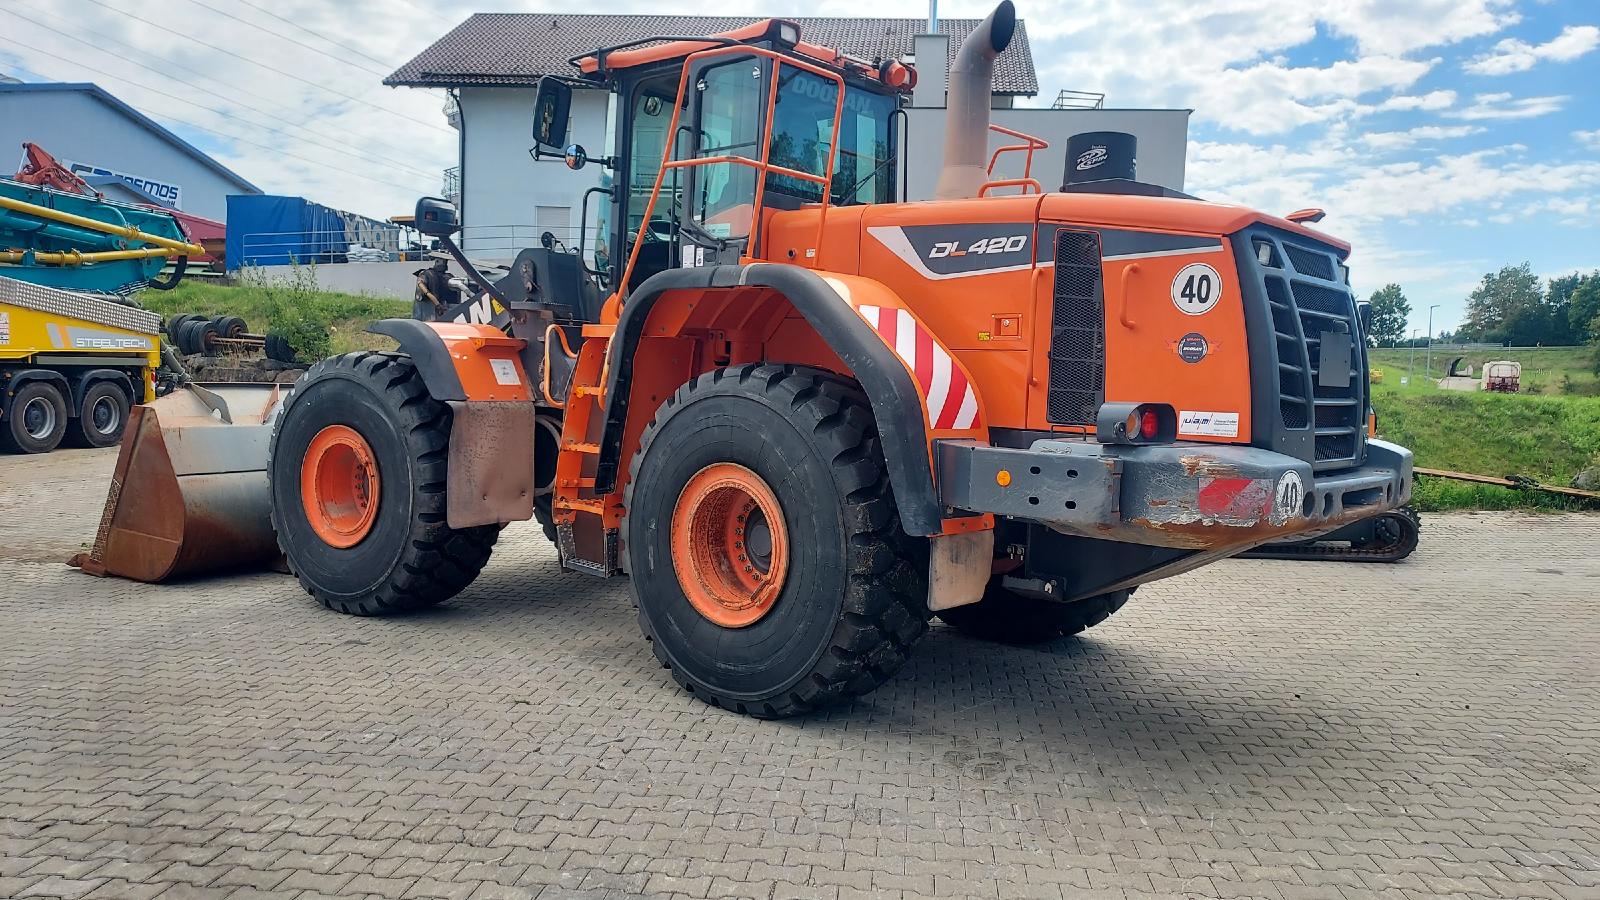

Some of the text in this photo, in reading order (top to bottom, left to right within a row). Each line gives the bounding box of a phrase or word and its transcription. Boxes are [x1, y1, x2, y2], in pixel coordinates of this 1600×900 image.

[928, 235, 1028, 259] DL420
[1180, 274, 1212, 304] 40
[75, 337, 146, 348] STEELTECH
[1280, 482, 1298, 514] 40
